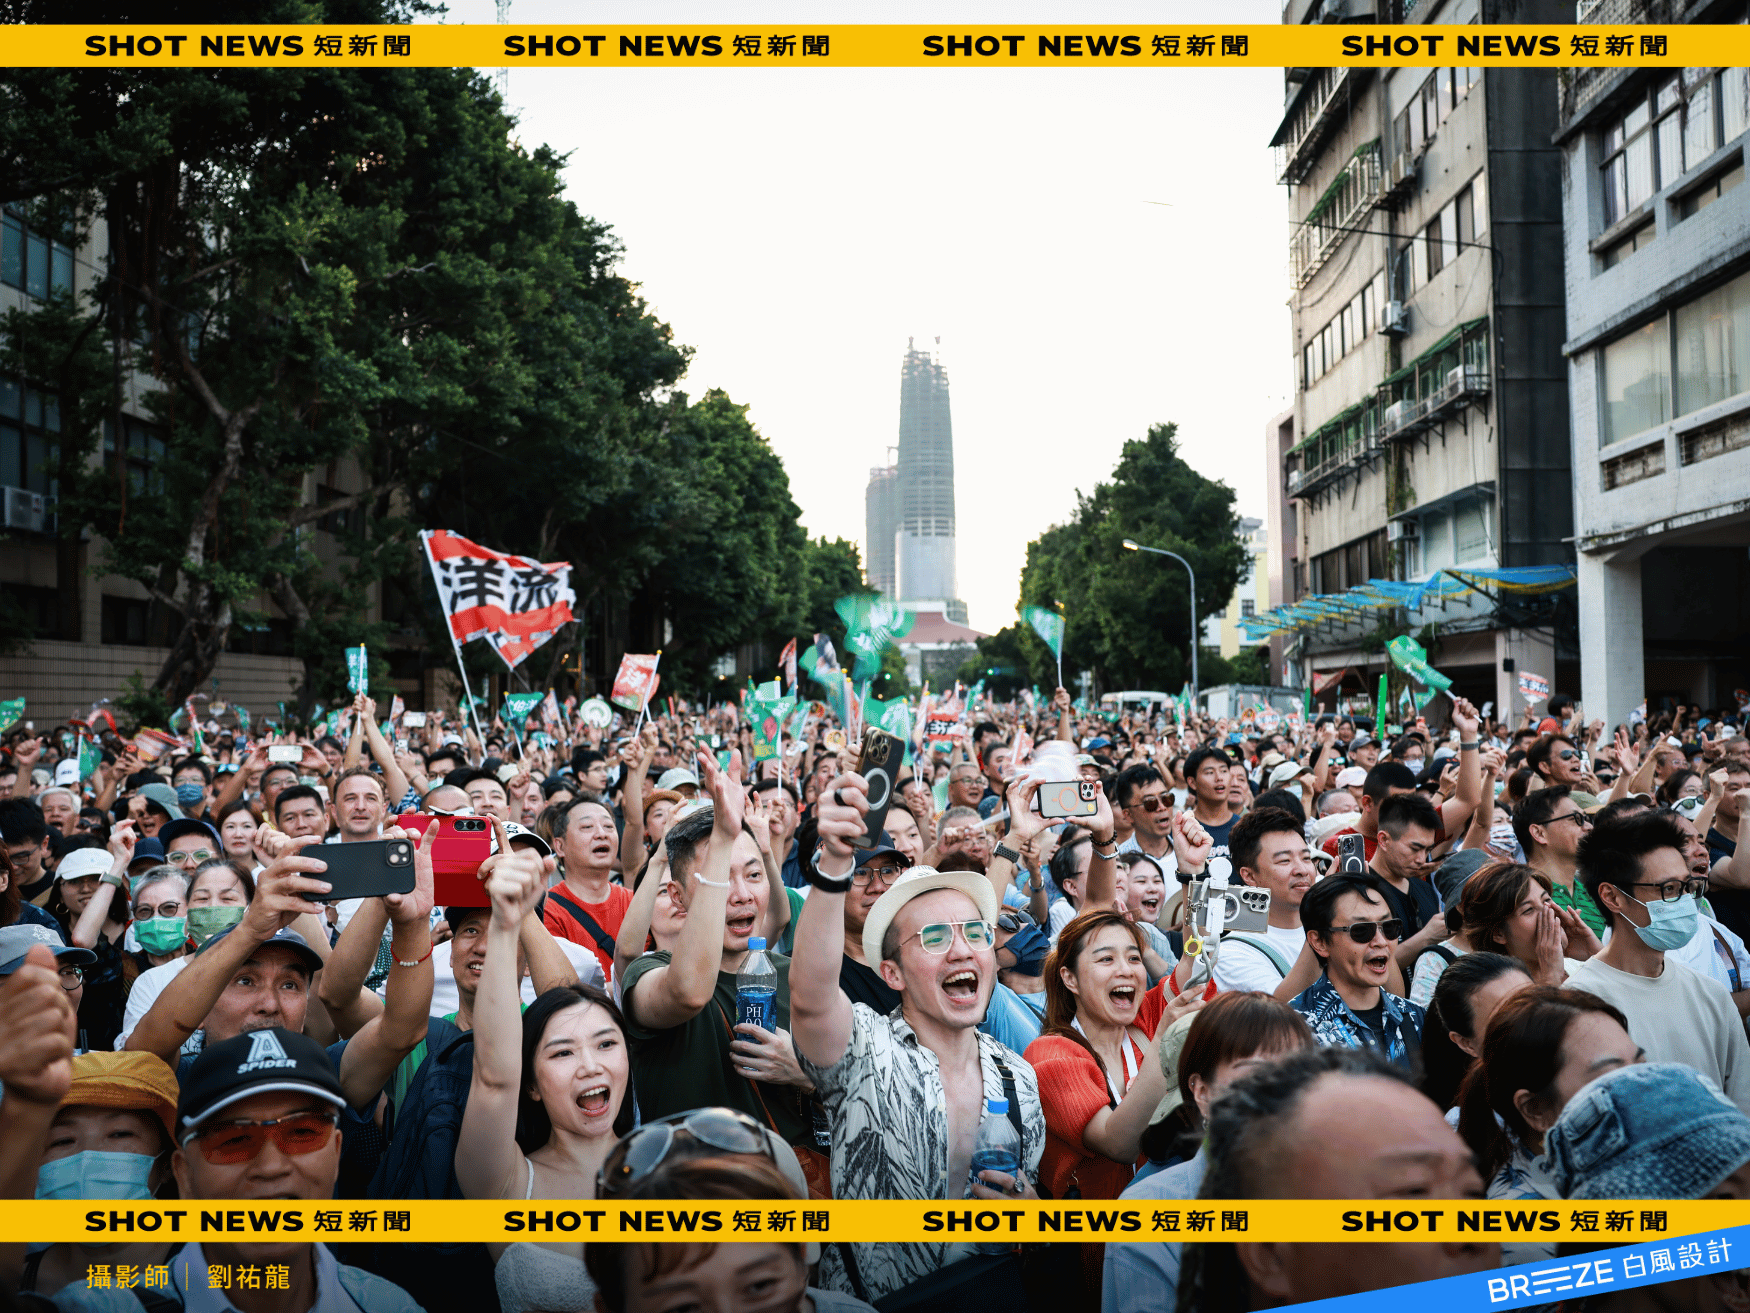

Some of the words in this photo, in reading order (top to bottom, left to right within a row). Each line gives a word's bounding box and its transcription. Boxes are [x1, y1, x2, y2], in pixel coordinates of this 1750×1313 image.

[439, 556, 559, 614] 洋流
[746, 1006, 762, 1017] PH
[247, 1030, 288, 1063] A
[237, 1058, 297, 1074] SPIDER
